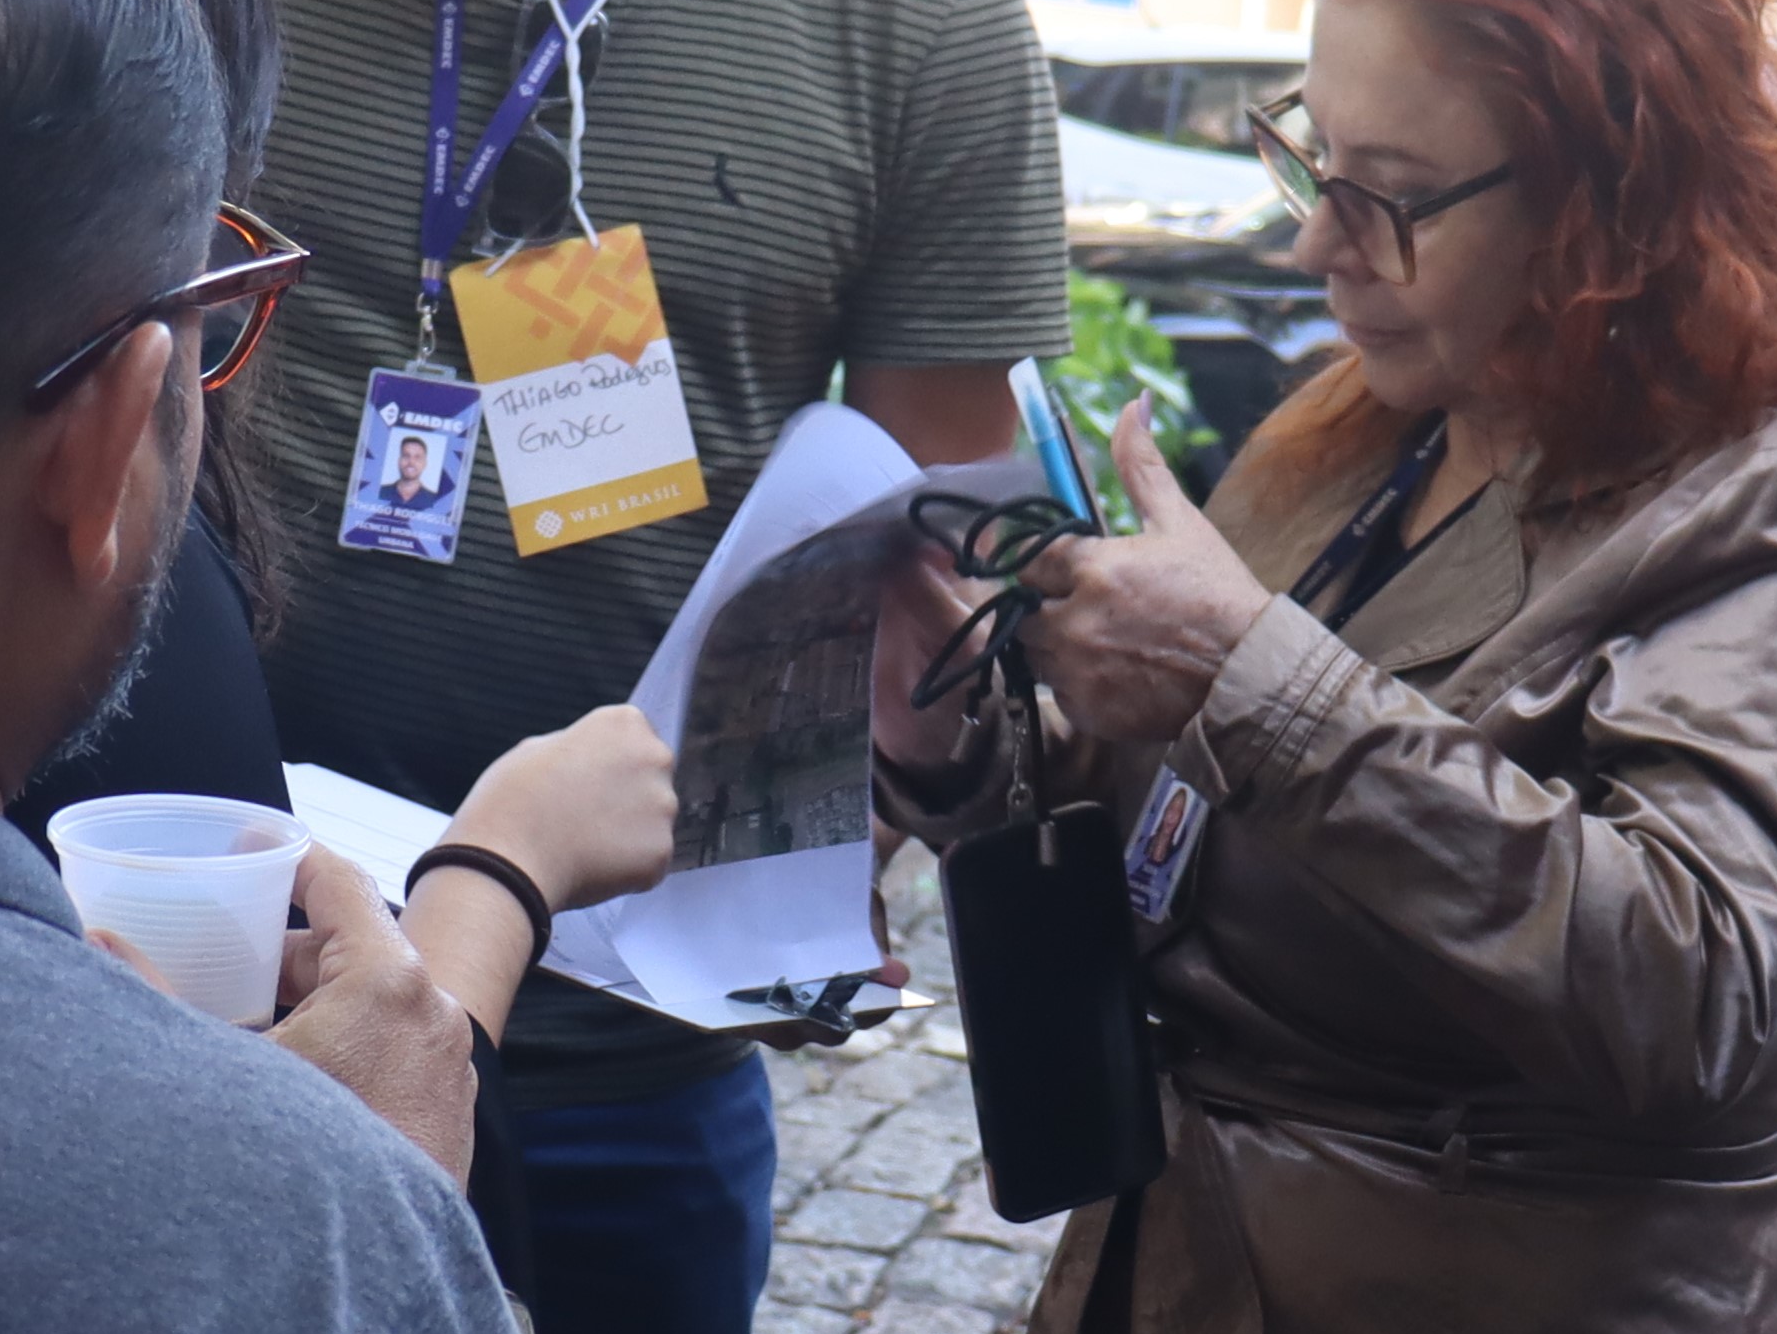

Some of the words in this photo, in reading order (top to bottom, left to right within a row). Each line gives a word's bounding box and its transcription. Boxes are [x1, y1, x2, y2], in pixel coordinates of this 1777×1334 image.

[440, 18, 453, 68] EMDEC
[527, 40, 562, 84] EMDEC
[432, 143, 447, 194] EMDEC
[463, 144, 497, 193] EMDEC
[403, 410, 464, 434] EMDEC
[569, 504, 610, 523] WRI
[618, 484, 683, 513] BRASIL
